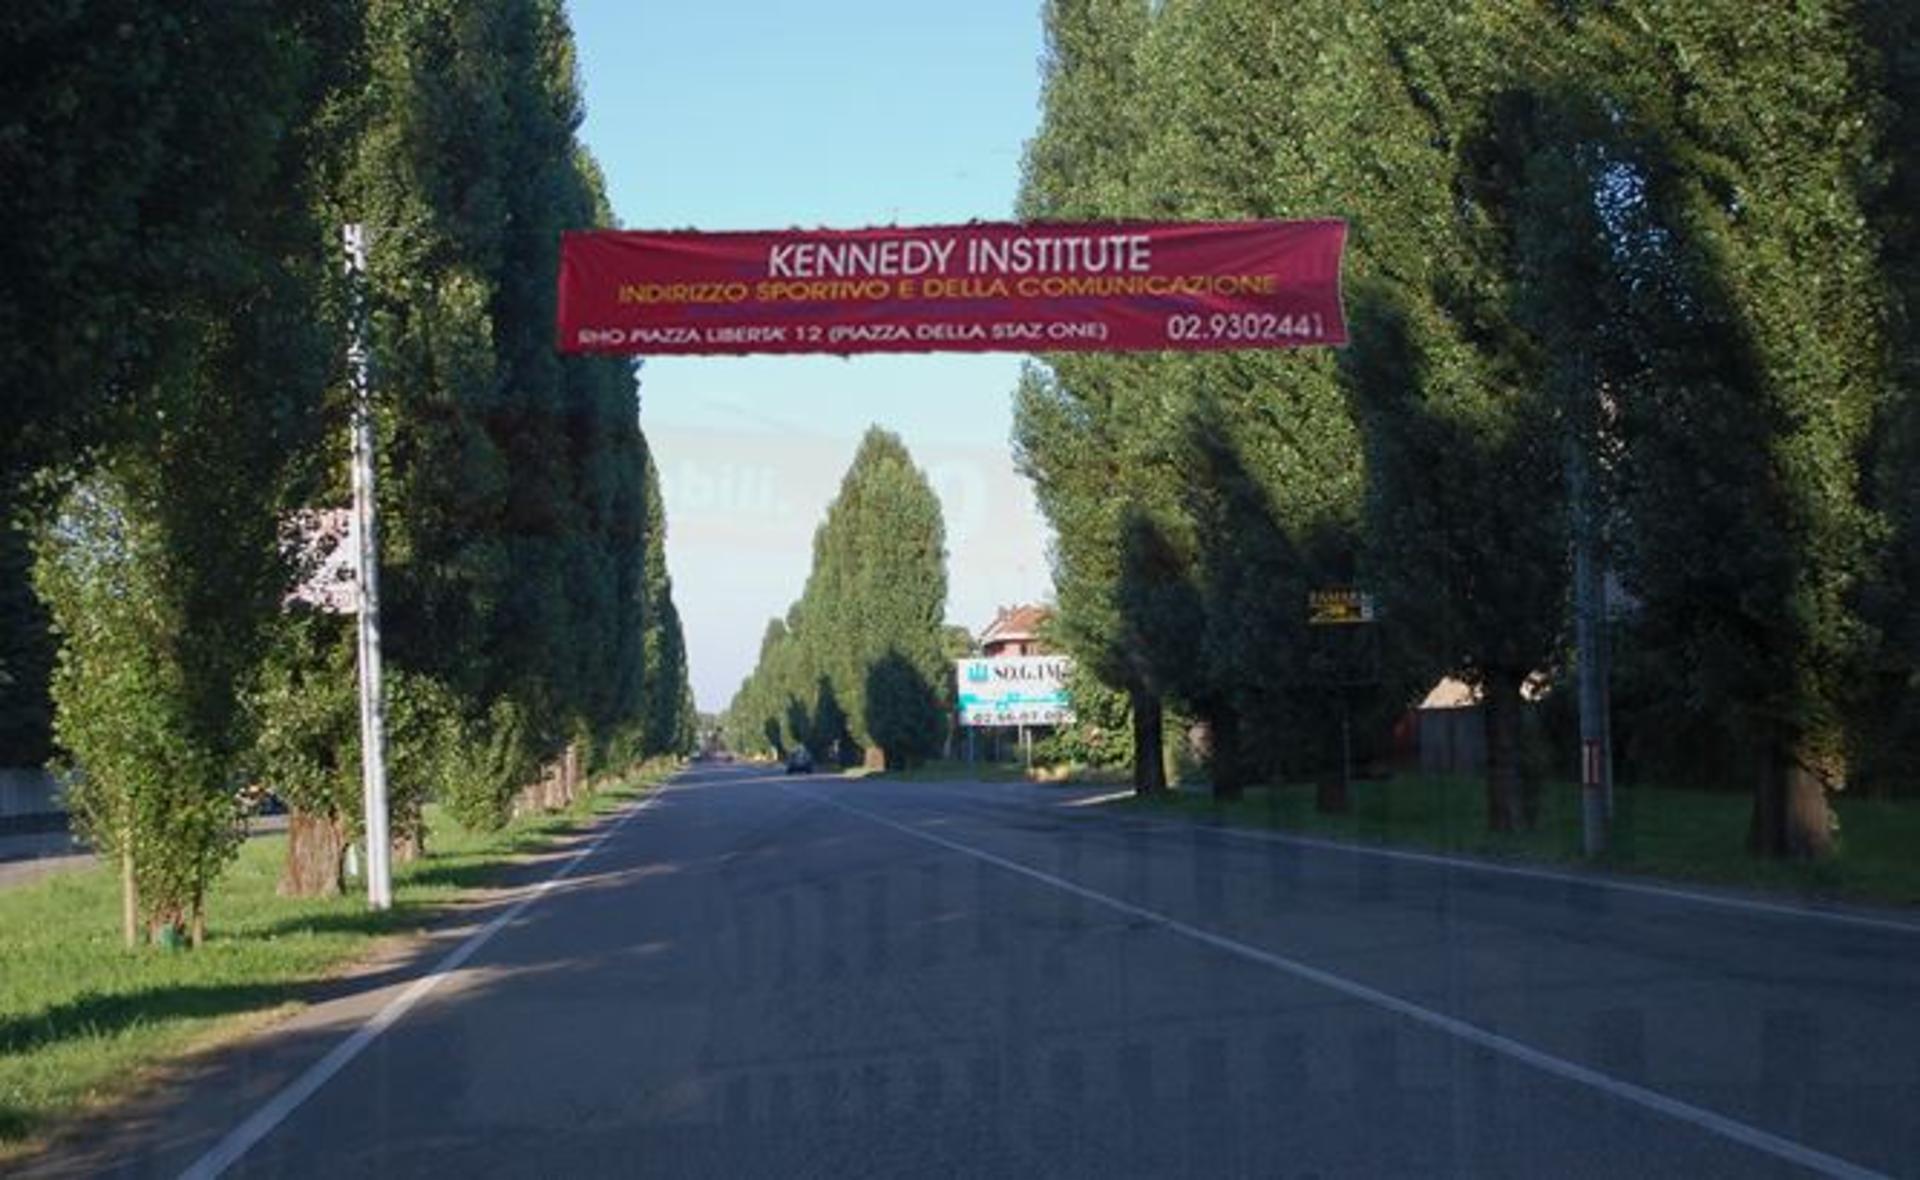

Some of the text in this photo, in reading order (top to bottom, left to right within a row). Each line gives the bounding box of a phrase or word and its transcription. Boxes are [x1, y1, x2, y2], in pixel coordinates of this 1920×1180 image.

[768, 235, 1152, 277] KENNEDY INSTITUTE
[619, 273, 1278, 305] INDIRIZZO SPORTIVO E DELLA COMUNICAZIONE
[629, 326, 702, 345] PIAZZA
[796, 325, 824, 342] 12
[915, 322, 987, 341] DELLA
[1167, 311, 1325, 341] 02.9302441
